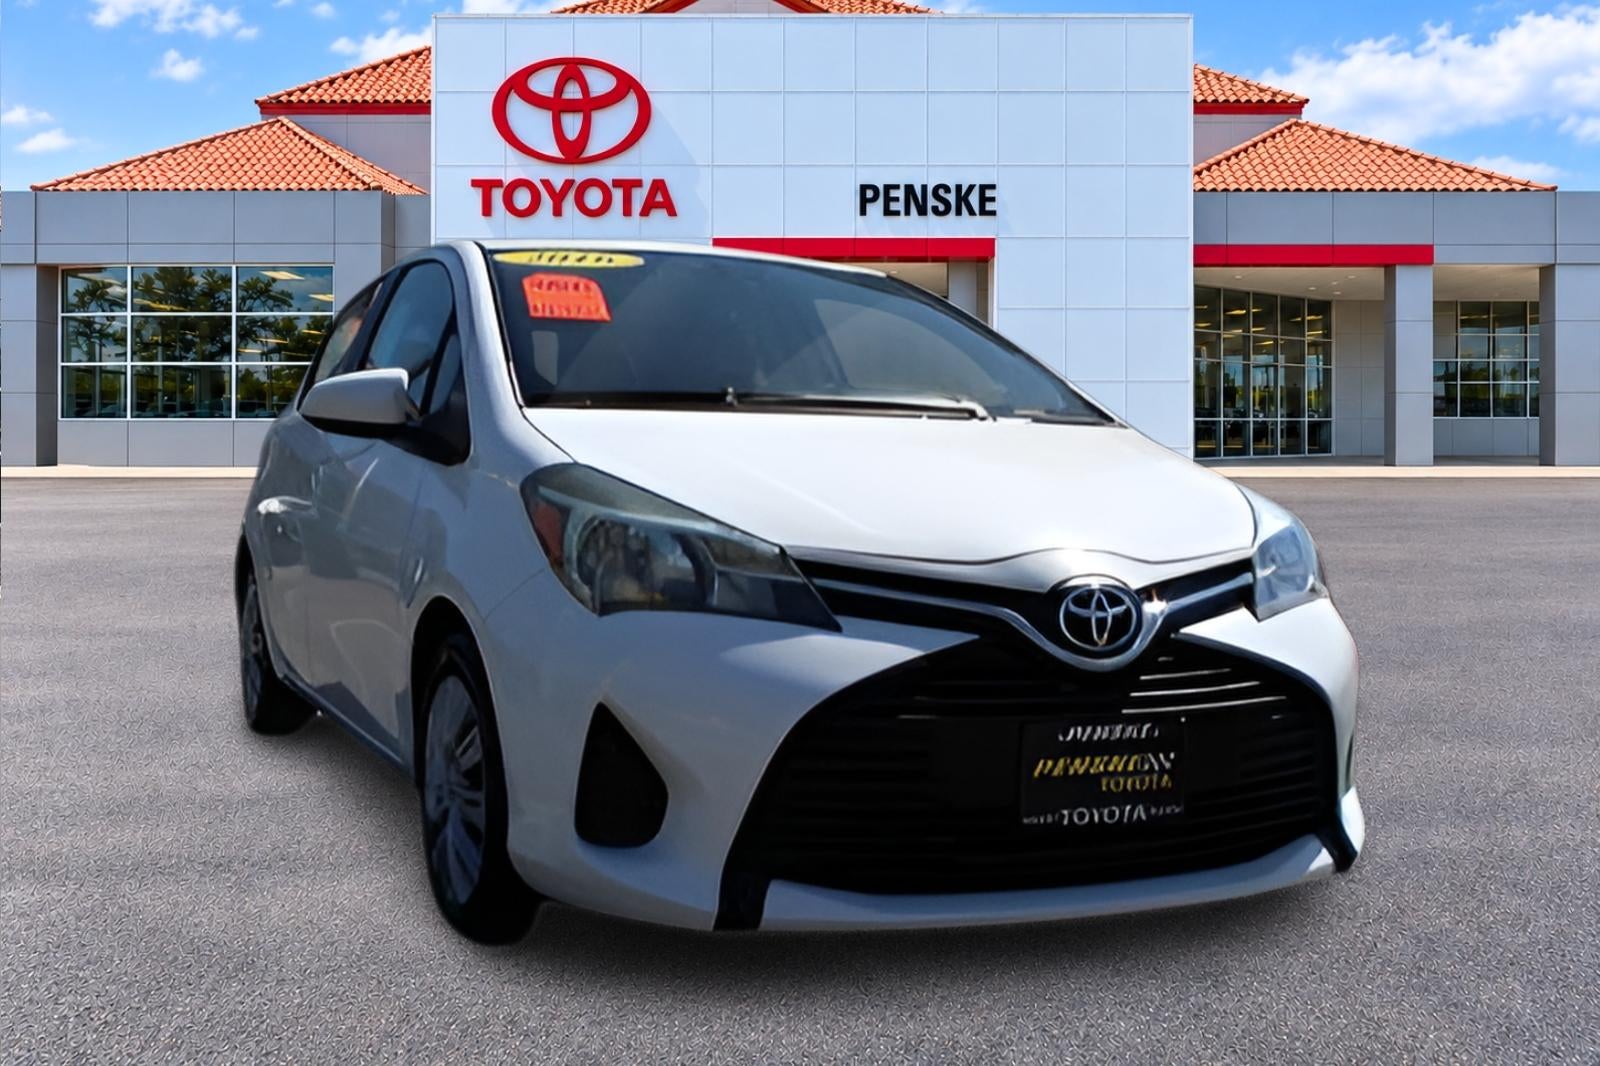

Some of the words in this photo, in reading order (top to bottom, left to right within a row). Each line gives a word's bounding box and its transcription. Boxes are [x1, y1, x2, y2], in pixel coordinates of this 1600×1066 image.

[470, 177, 678, 218] TOYOTA
[859, 183, 997, 217] PENSKE
[1060, 803, 1147, 826] TOYOTA
